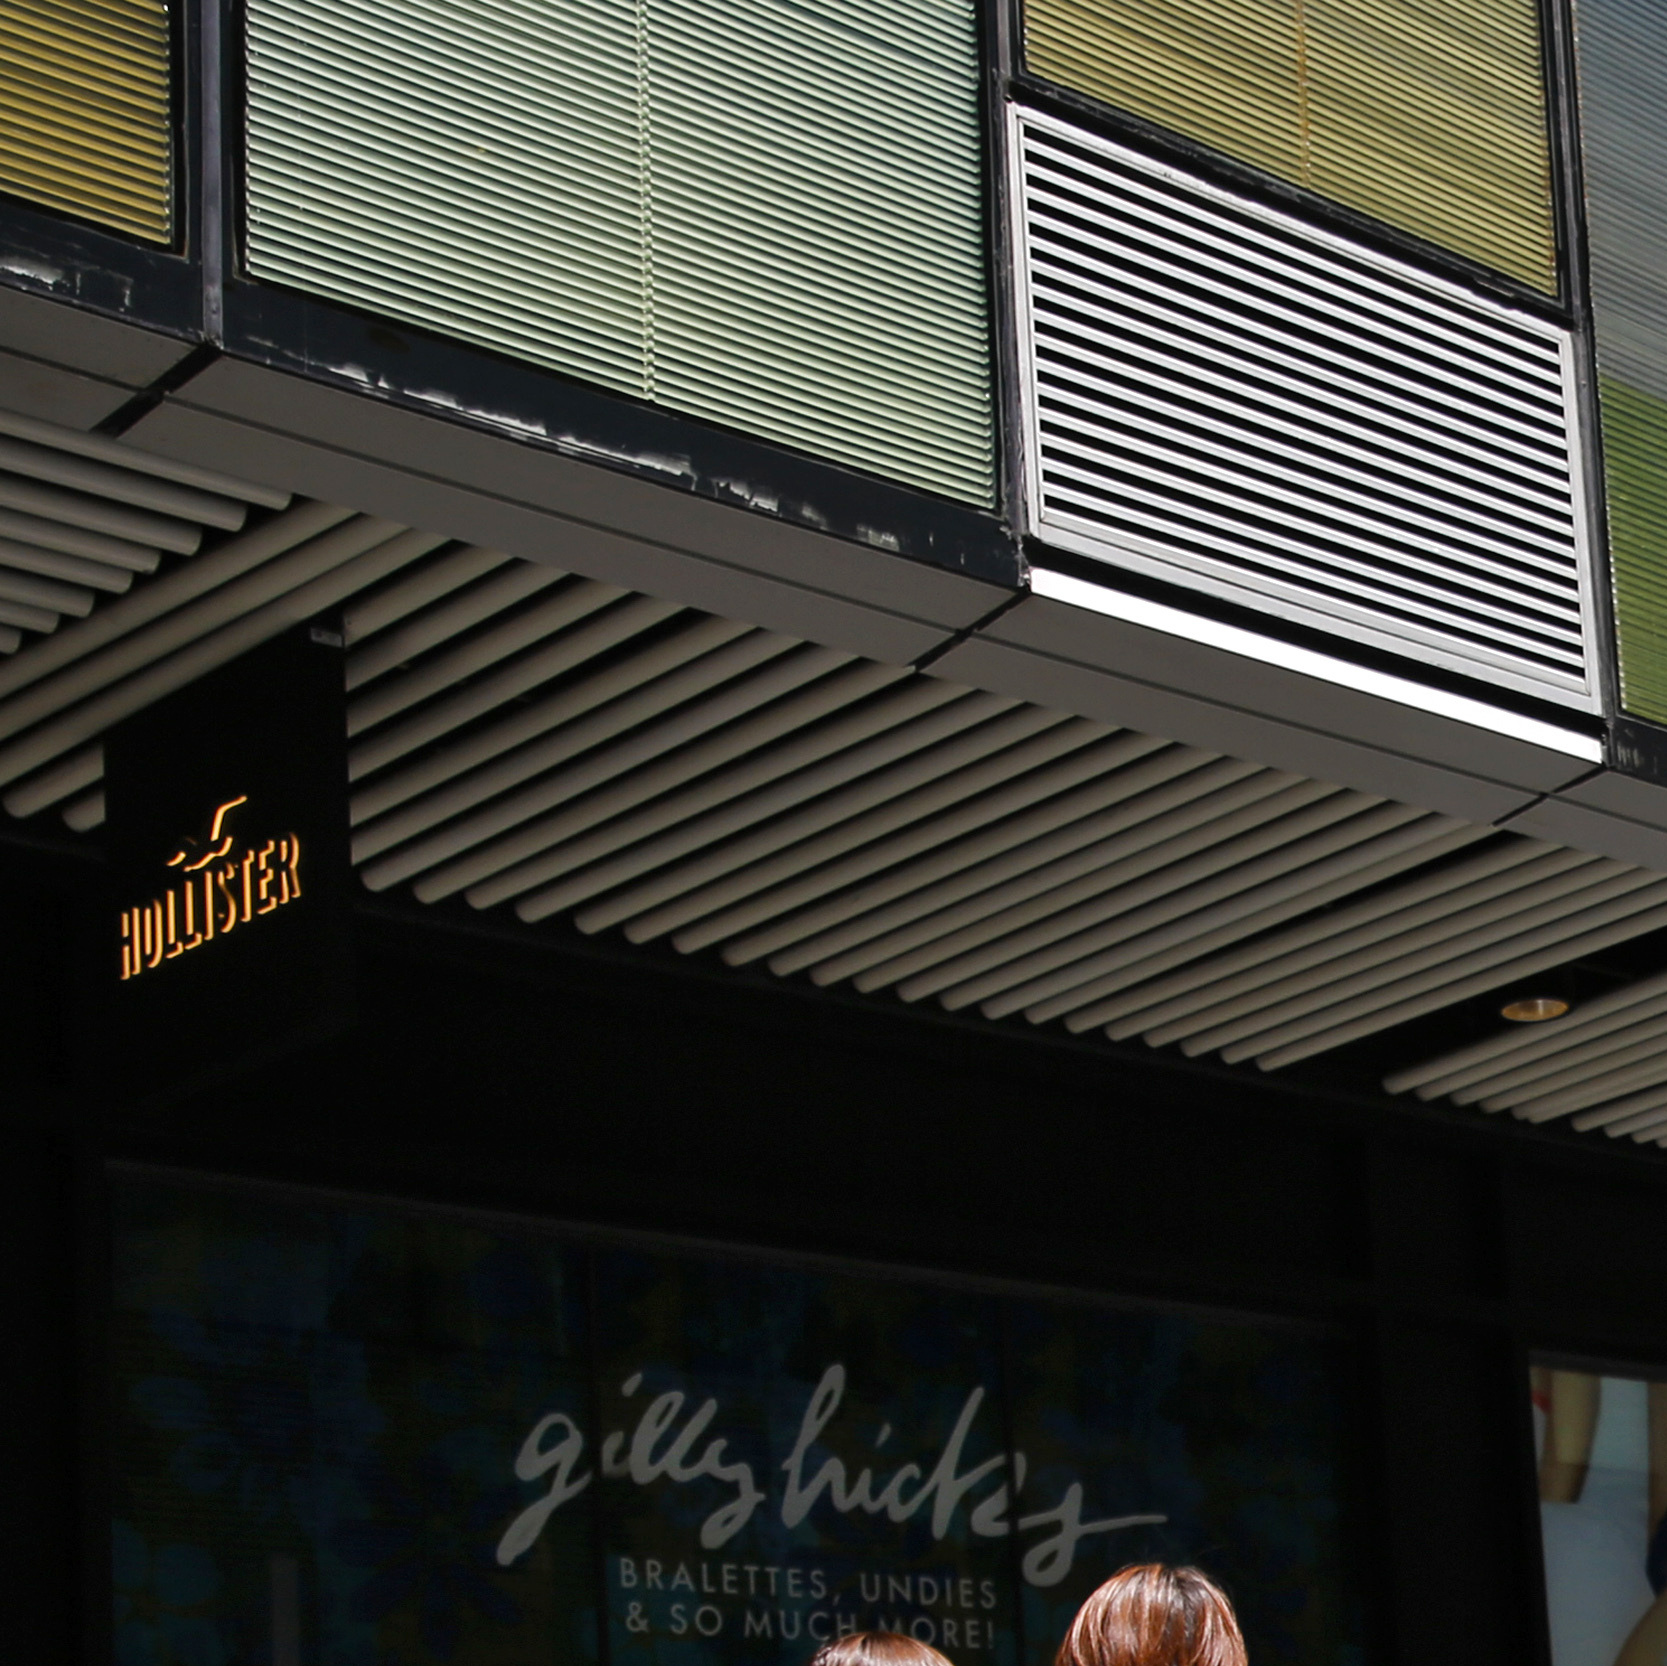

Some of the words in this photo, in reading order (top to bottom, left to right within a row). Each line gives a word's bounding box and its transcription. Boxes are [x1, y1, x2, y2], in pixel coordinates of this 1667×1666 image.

[120, 831, 301, 980] HOLLISTER
[496, 1372, 766, 1567] gilly
[618, 1556, 843, 1606] BRALETTES,
[858, 1571, 998, 1611] UNDIES
[624, 1601, 652, 1634] &
[669, 1603, 724, 1638] SO
[742, 1608, 858, 1642] MUCH
[877, 1606, 994, 1650] MORE!
